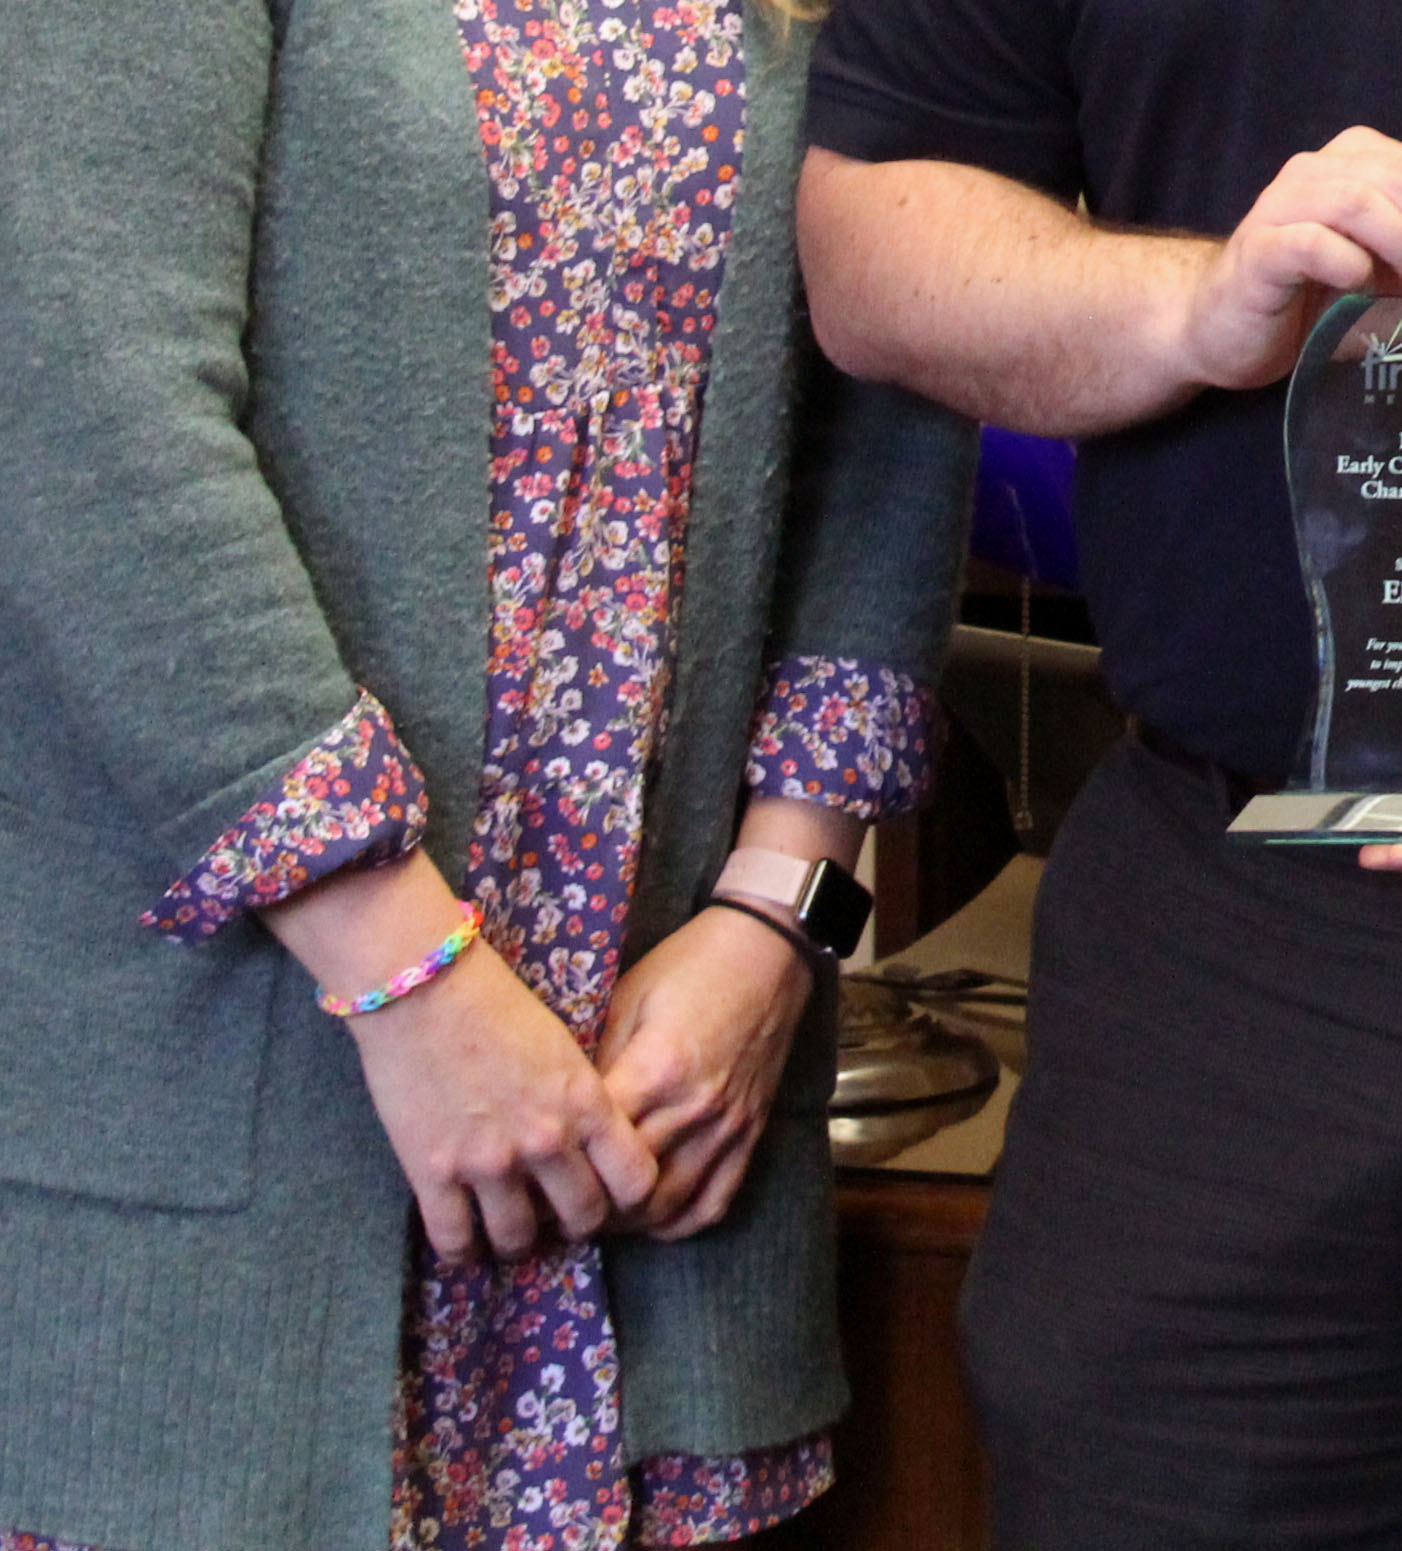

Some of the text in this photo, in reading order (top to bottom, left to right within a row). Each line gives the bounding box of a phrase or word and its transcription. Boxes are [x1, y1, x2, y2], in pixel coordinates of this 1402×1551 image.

[1336, 454, 1385, 478] Early
[1366, 637, 1385, 651] For
[1370, 659, 1382, 670] to
[1345, 678, 1391, 693] youngest
